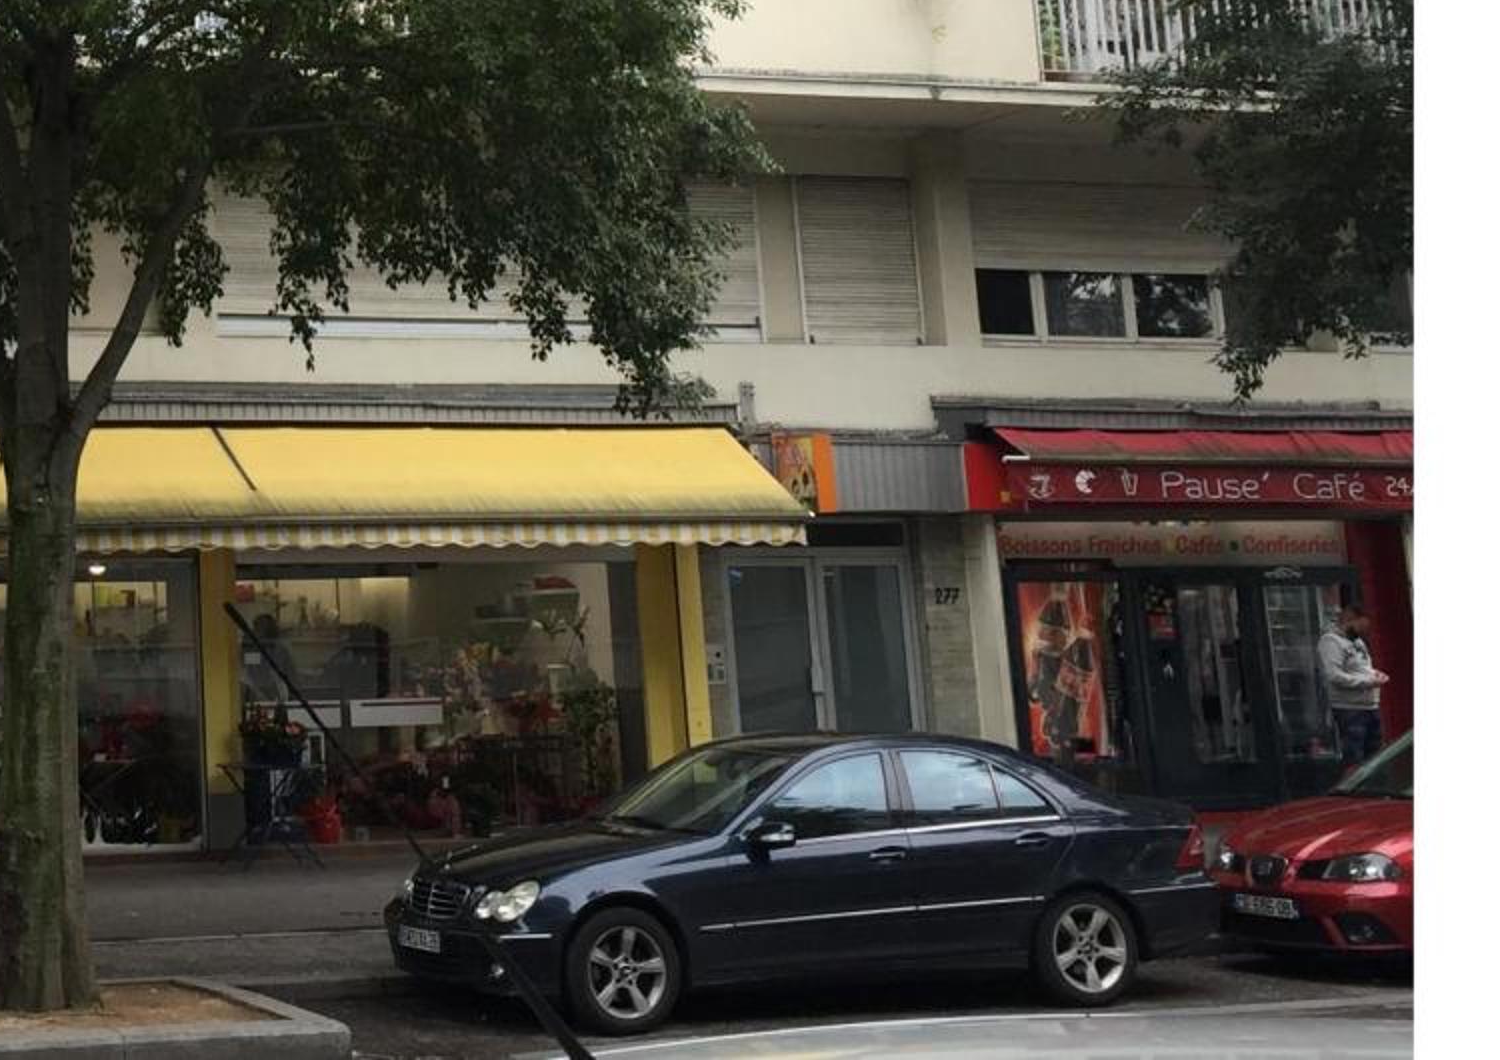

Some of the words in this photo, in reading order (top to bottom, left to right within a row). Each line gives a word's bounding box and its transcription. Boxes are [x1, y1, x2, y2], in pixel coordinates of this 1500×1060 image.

[1292, 472, 1365, 500] Café
[1384, 476, 1414, 497] 24
[999, 534, 1081, 554] Boissons
[934, 587, 960, 605] 277
